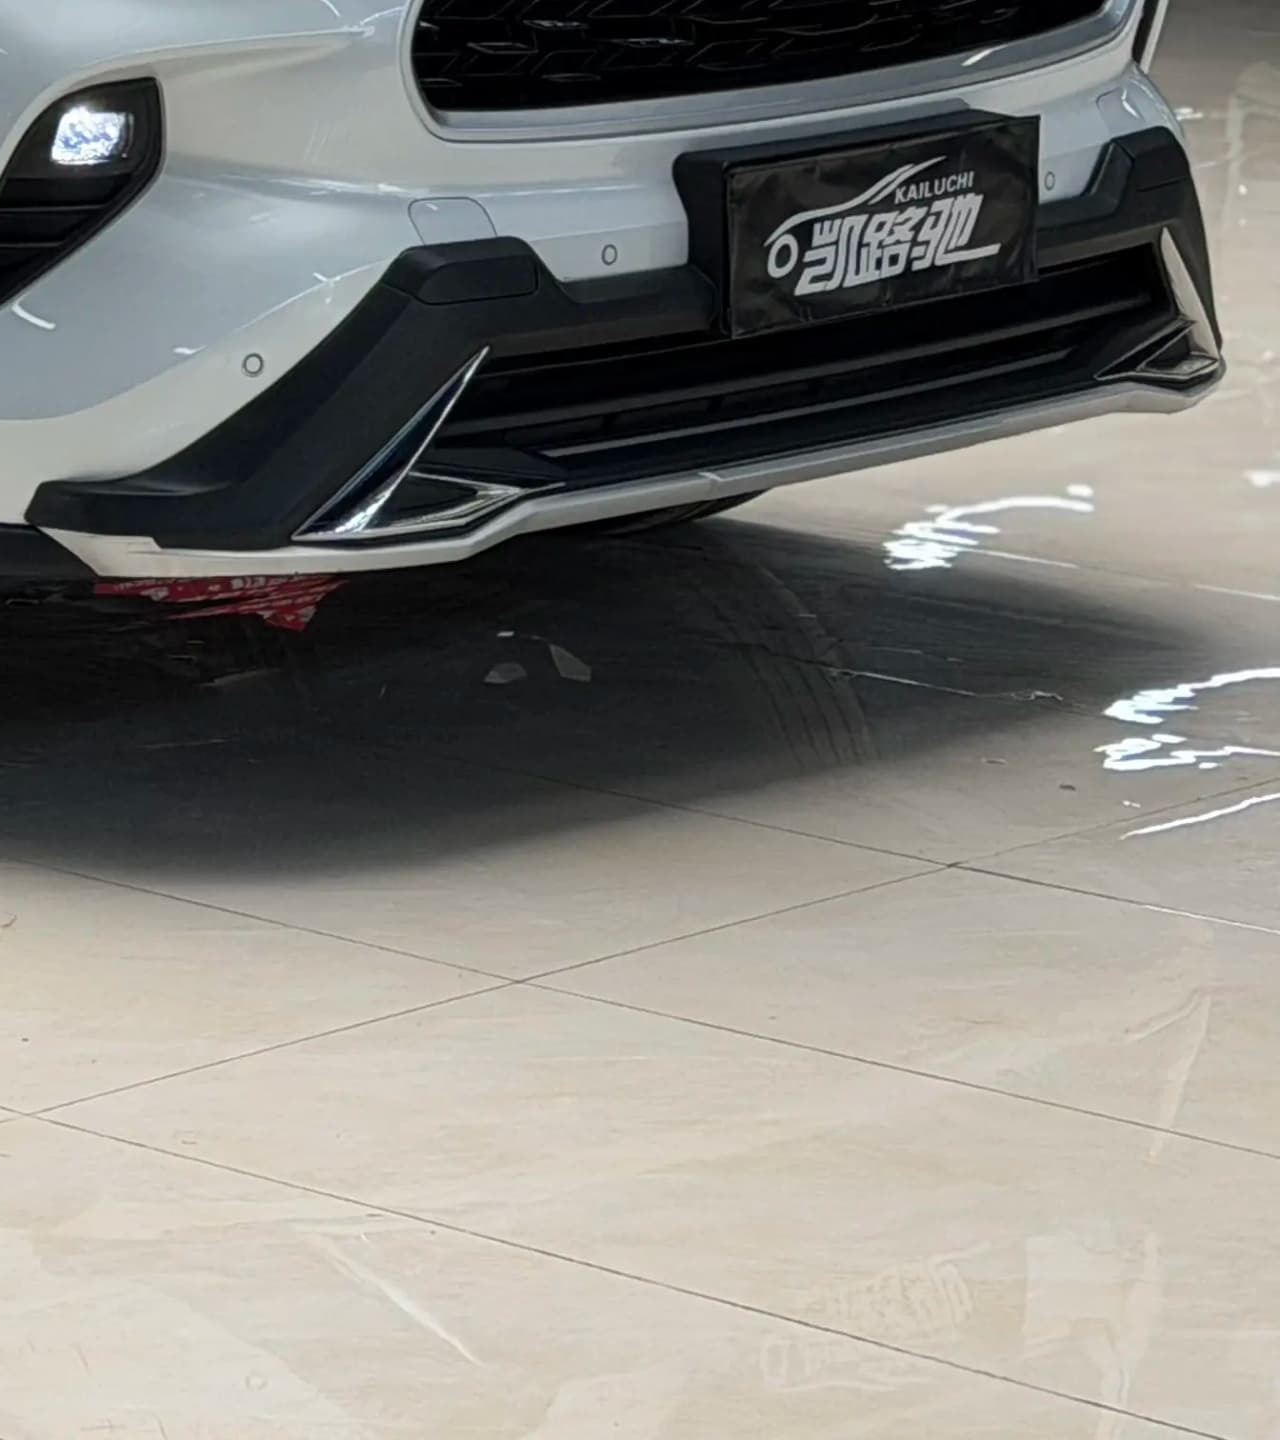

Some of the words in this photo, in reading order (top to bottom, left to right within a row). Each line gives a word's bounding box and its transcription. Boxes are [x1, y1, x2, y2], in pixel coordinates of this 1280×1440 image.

[894, 171, 975, 205] KAILUCHI
[794, 193, 1001, 296] 凯路驰
